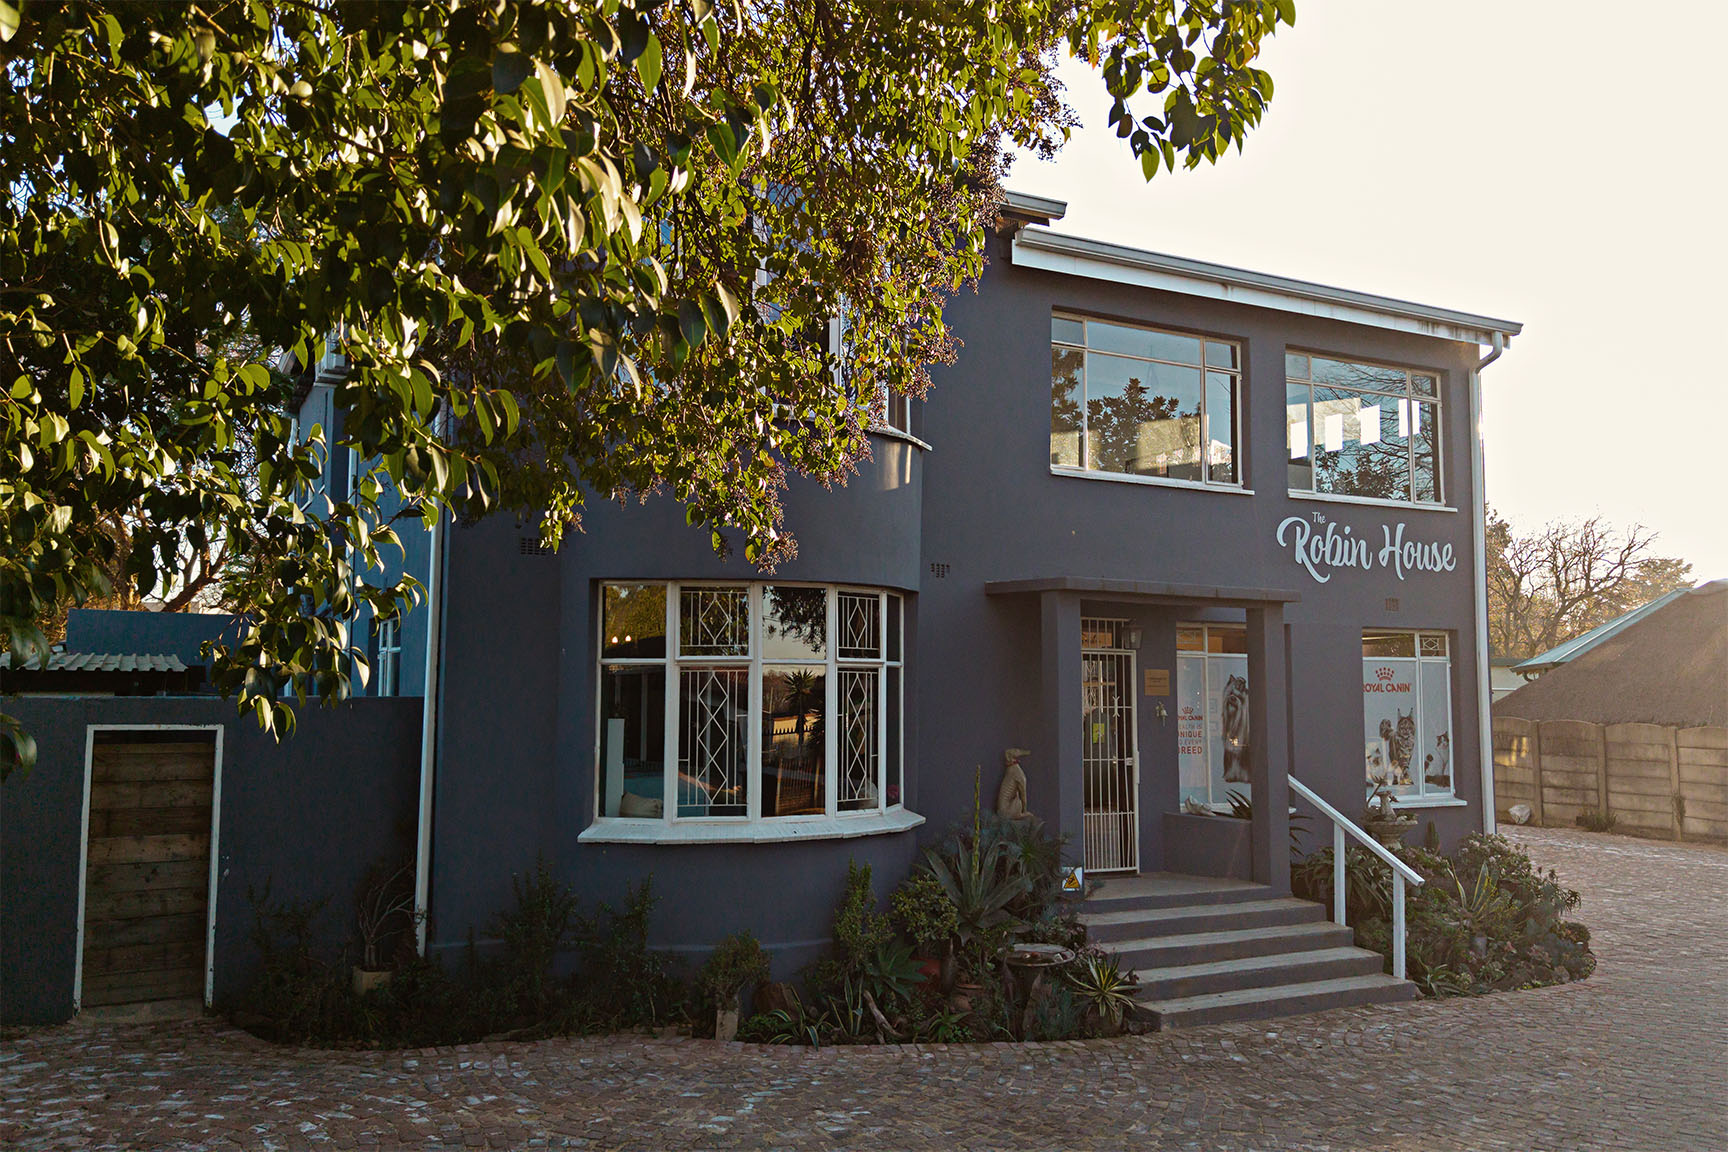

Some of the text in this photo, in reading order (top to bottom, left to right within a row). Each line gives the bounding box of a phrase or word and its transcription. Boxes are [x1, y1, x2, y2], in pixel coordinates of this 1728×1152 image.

[1312, 511, 1327, 525] The
[1276, 516, 1457, 584] Robin House
[1385, 682, 1410, 693] CANIN
[1178, 730, 1203, 738] NIQUE
